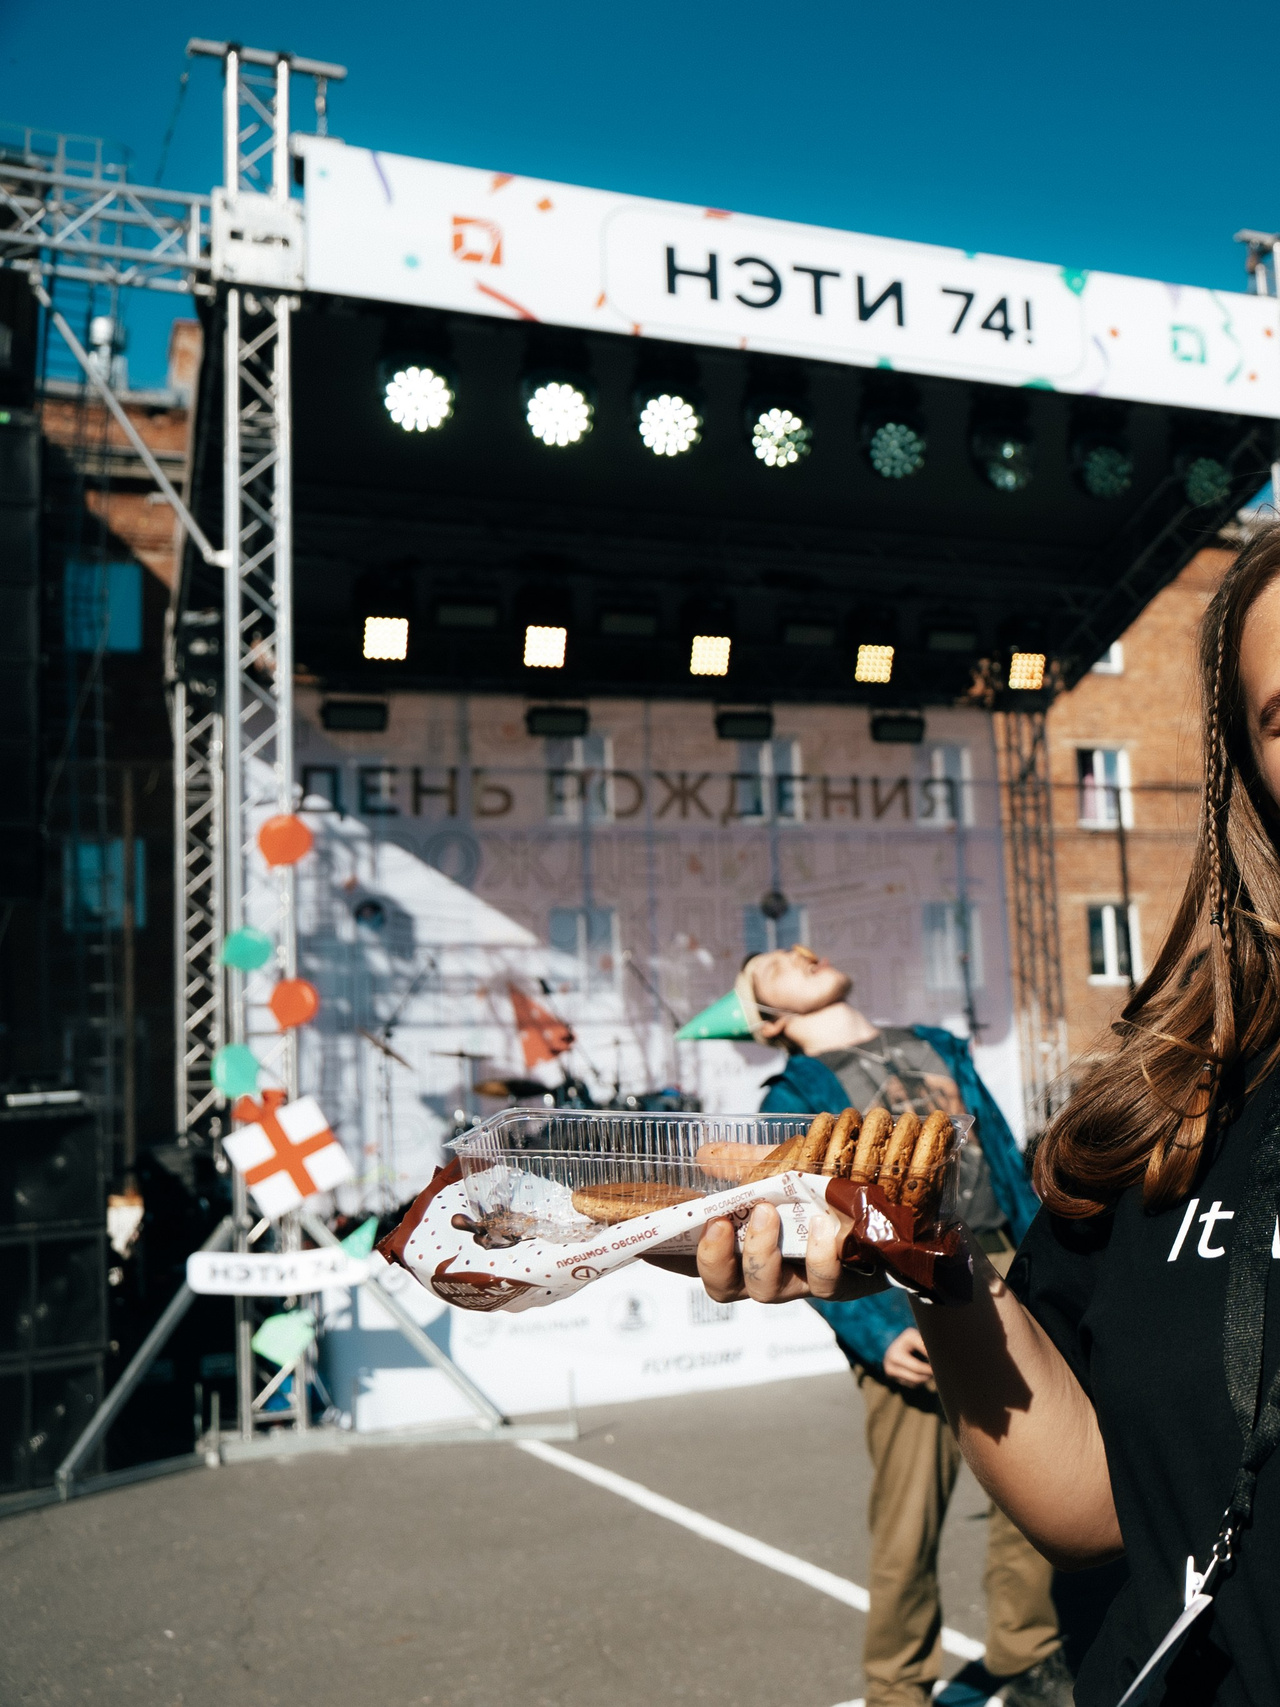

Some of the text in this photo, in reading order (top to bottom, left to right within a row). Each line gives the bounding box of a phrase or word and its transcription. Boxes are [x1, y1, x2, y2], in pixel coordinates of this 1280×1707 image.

[665, 246, 1034, 345] НЭТИ 74!
[300, 765, 959, 827] ДЕНЬ РОЖДЕНИЯ
[704, 1205, 718, 1215] ПРО
[718, 1189, 756, 1209] СЛАДОСТИ!
[1167, 1198, 1234, 1262] It
[208, 1262, 300, 1282] НЭТИ
[556, 1246, 608, 1269] ЛЮБИМОЕ
